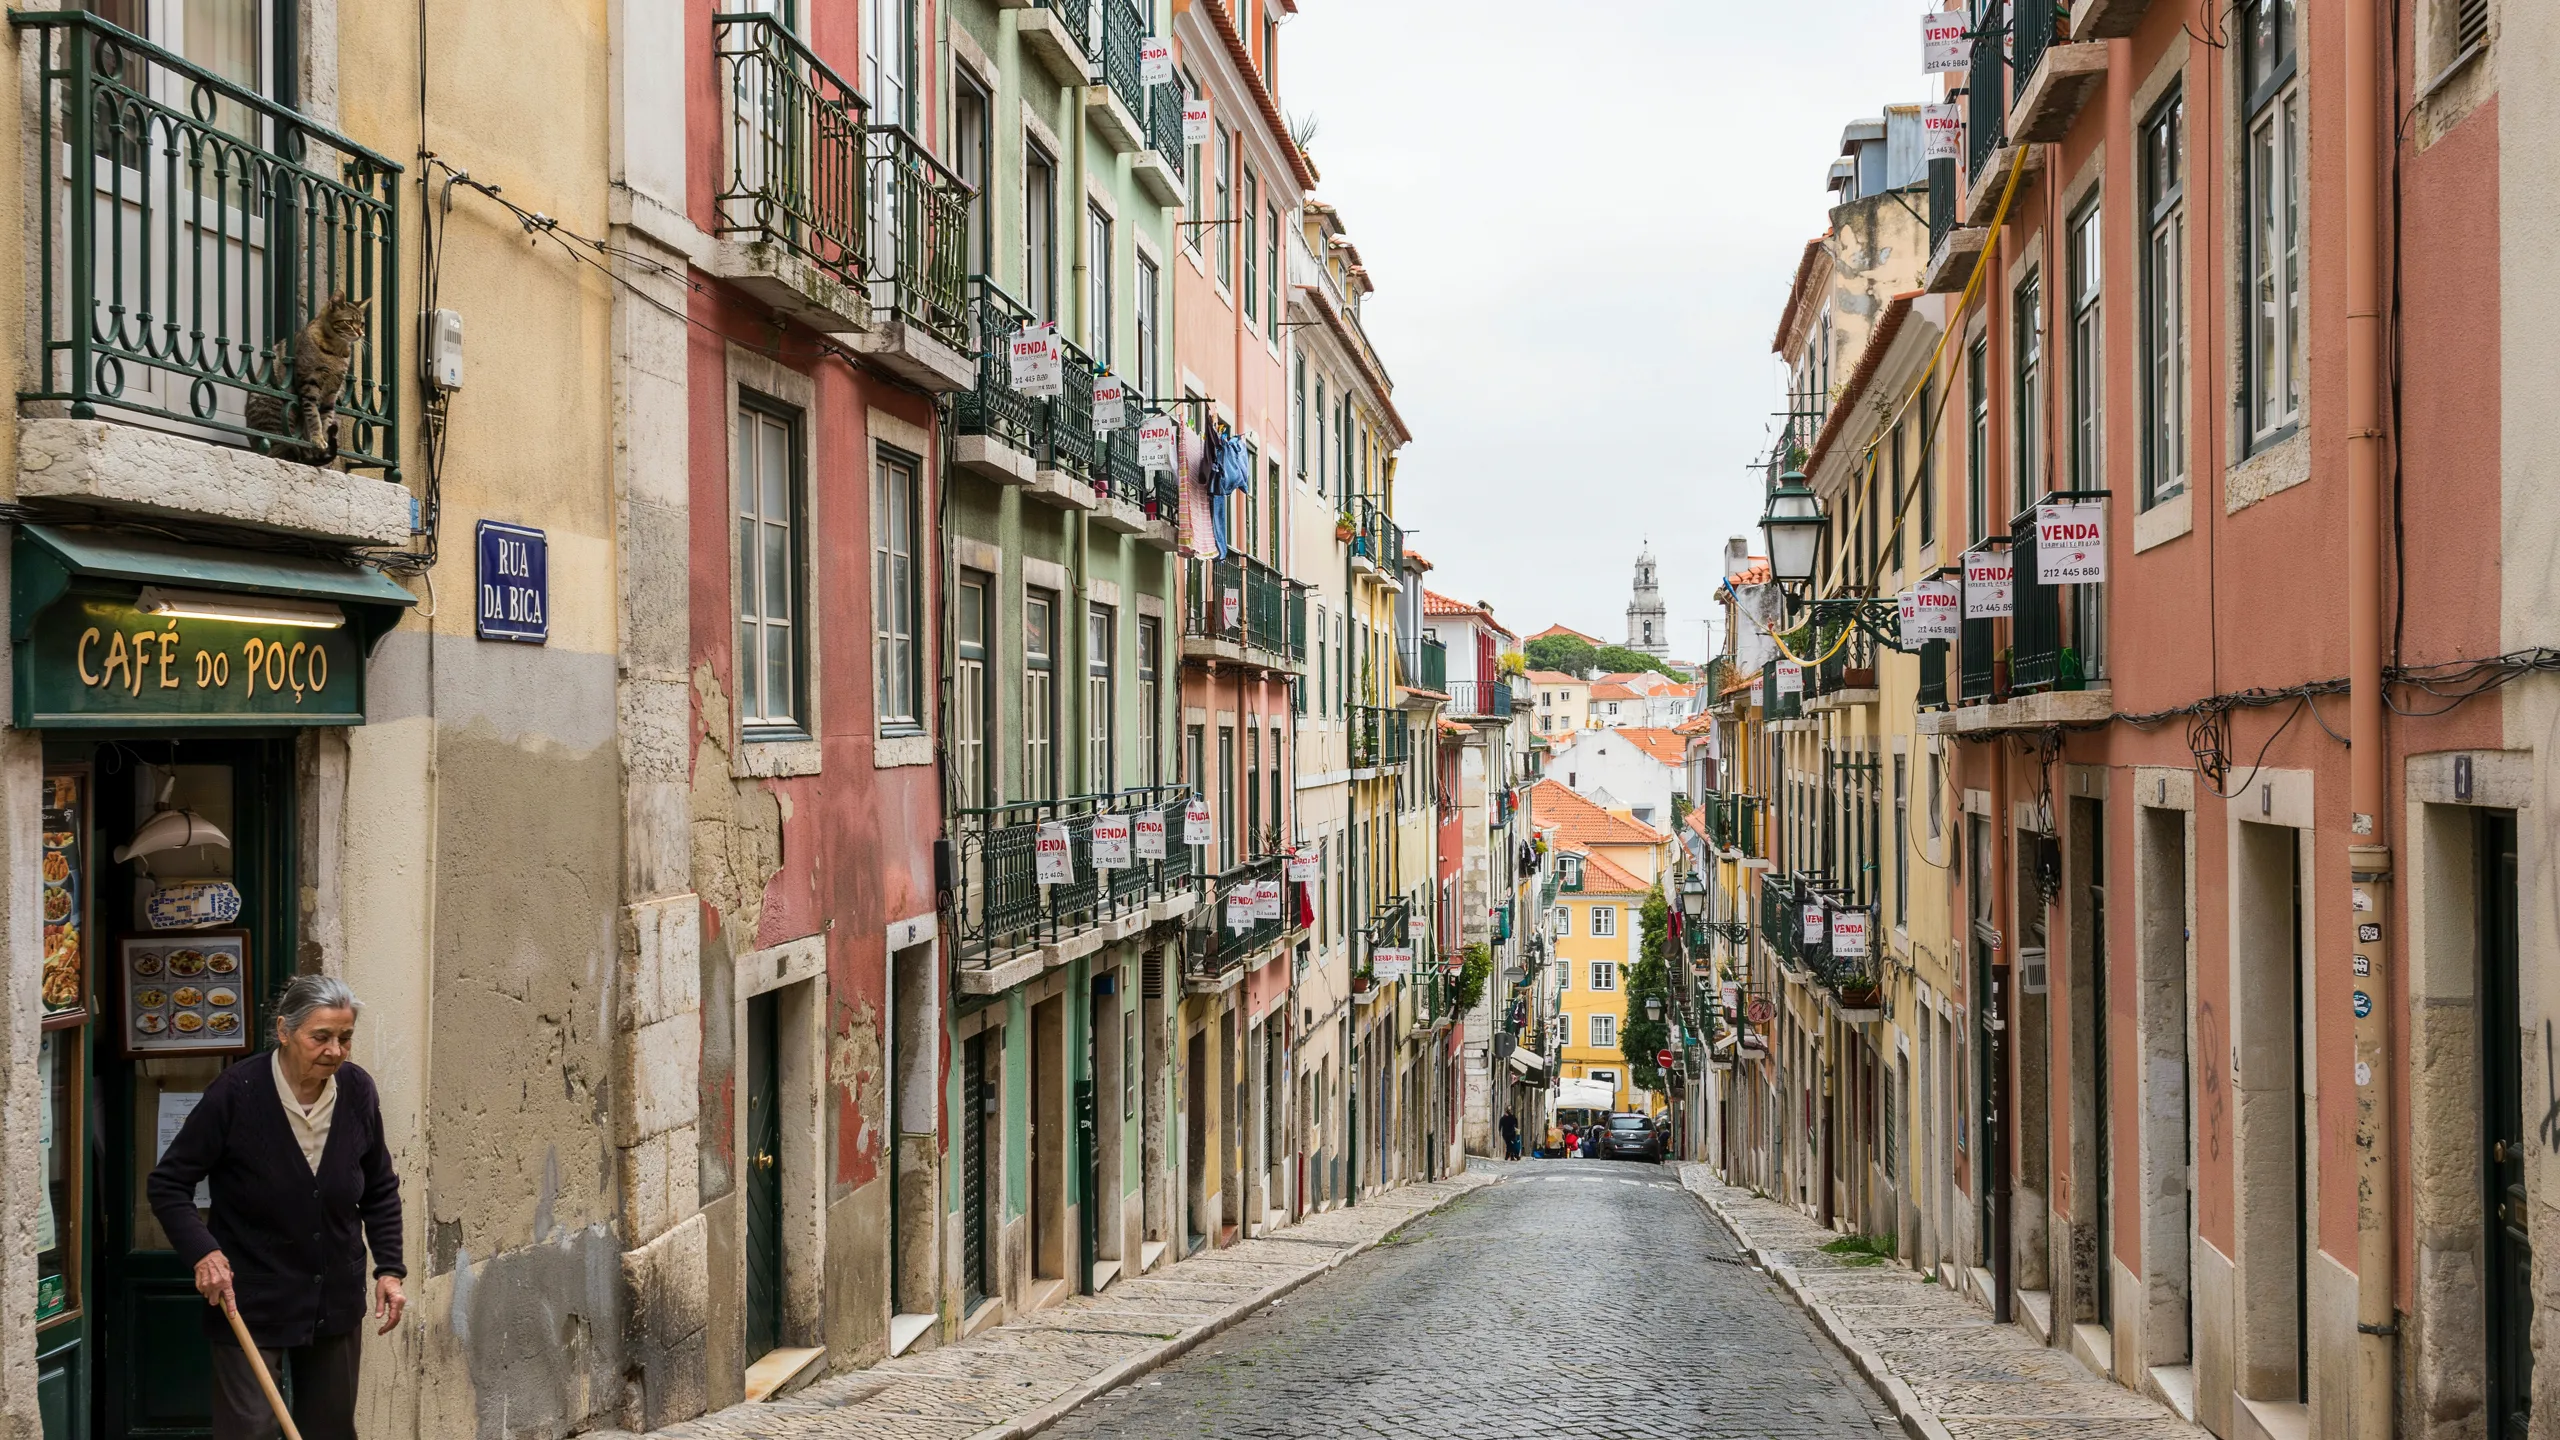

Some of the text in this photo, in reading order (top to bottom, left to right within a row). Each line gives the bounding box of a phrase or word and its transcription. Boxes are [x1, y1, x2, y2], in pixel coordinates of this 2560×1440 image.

[1926, 26, 1967, 40] VENDA
[1182, 111, 1207, 120] ENDA
[1013, 340, 1047, 355] VENDA
[1140, 428, 1169, 439] VENDA
[2041, 523, 2100, 540] VENDA
[498, 538, 529, 577] RUA
[2043, 567, 2100, 577] 212 445 880
[484, 588, 543, 624] DA BICA
[1918, 594, 1957, 606] VENDA
[78, 619, 328, 704] CAFÉ DO POÇO
[1136, 822, 1163, 832] VENDA
[1095, 828, 1128, 839] VENDA
[1834, 924, 1863, 933] VENDA
